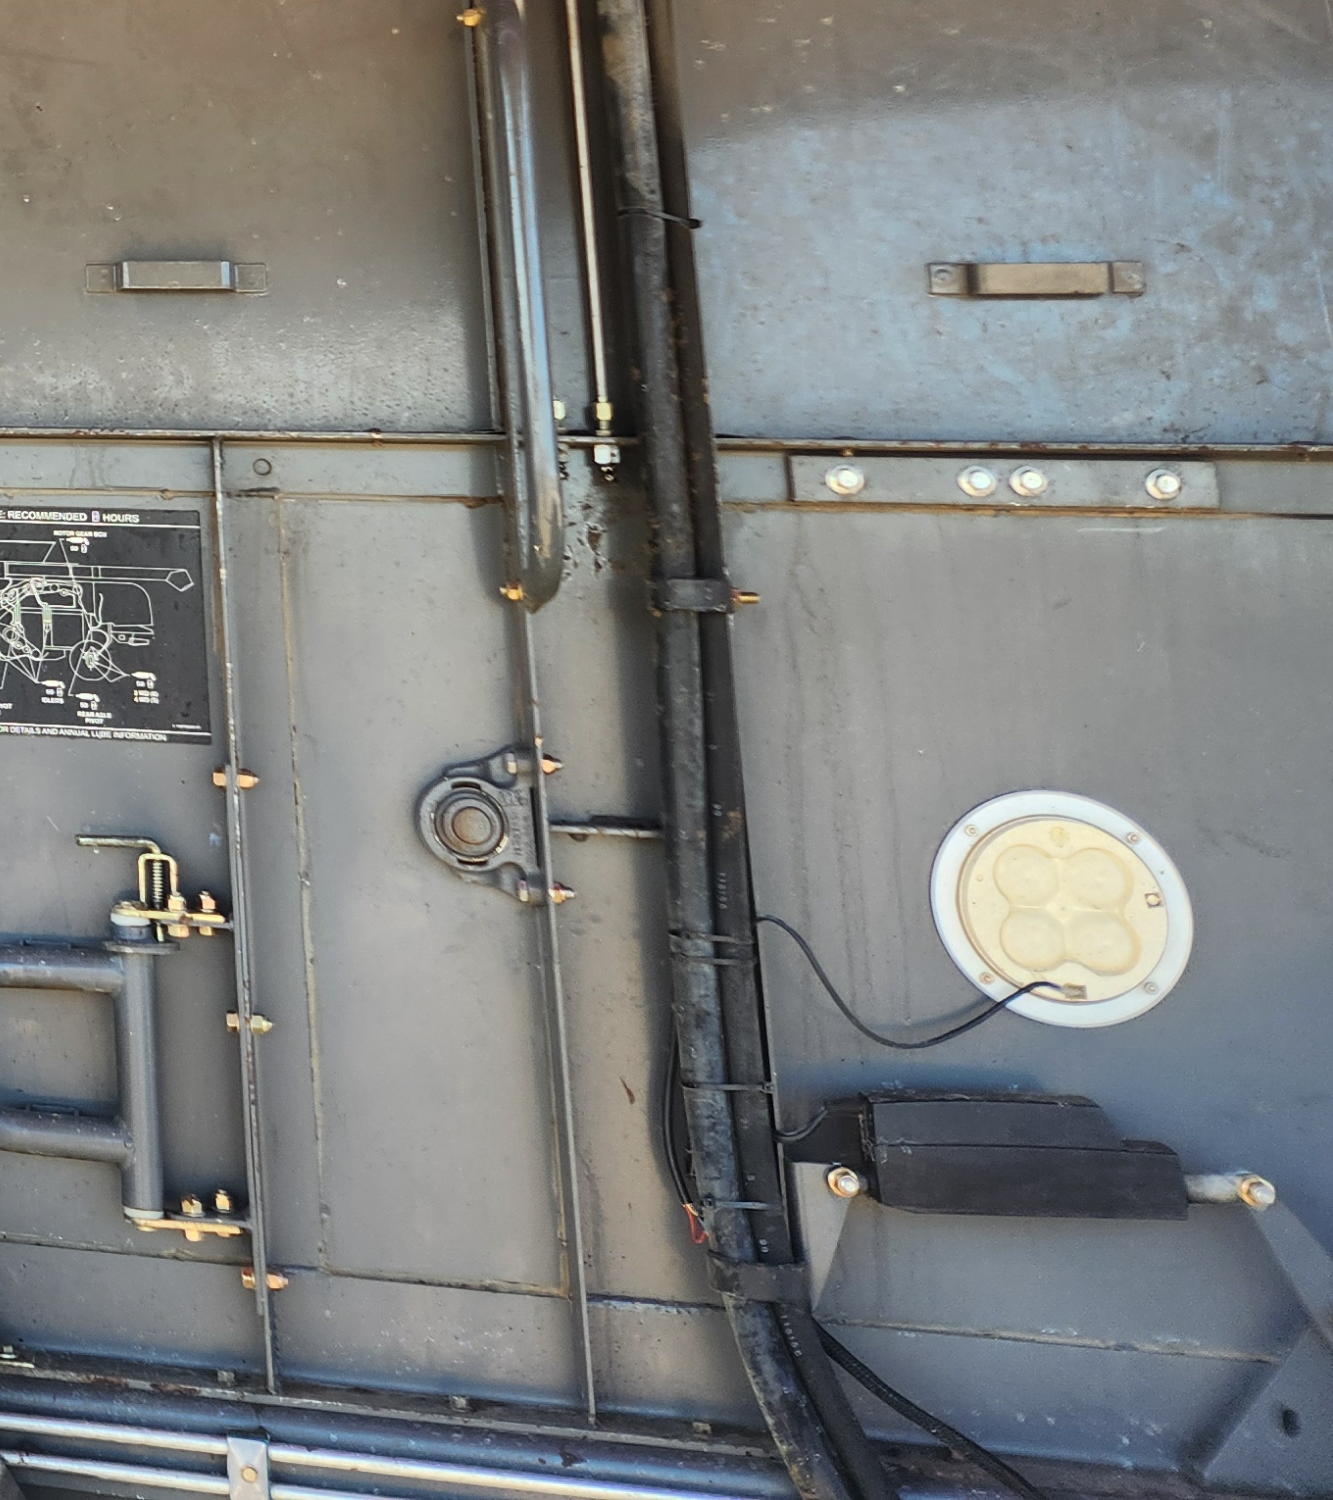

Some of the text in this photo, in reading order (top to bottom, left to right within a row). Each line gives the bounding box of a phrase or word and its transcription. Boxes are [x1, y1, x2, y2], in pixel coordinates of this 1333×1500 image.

[7, 510, 88, 522] RECOMMENDED
[103, 514, 139, 523] HOURS
[10, 726, 41, 735] DETAILS
[42, 728, 58, 736] AND
[59, 729, 90, 738] ANNUAL
[91, 730, 112, 739] LUBE
[113, 731, 167, 742] INFORMATION
